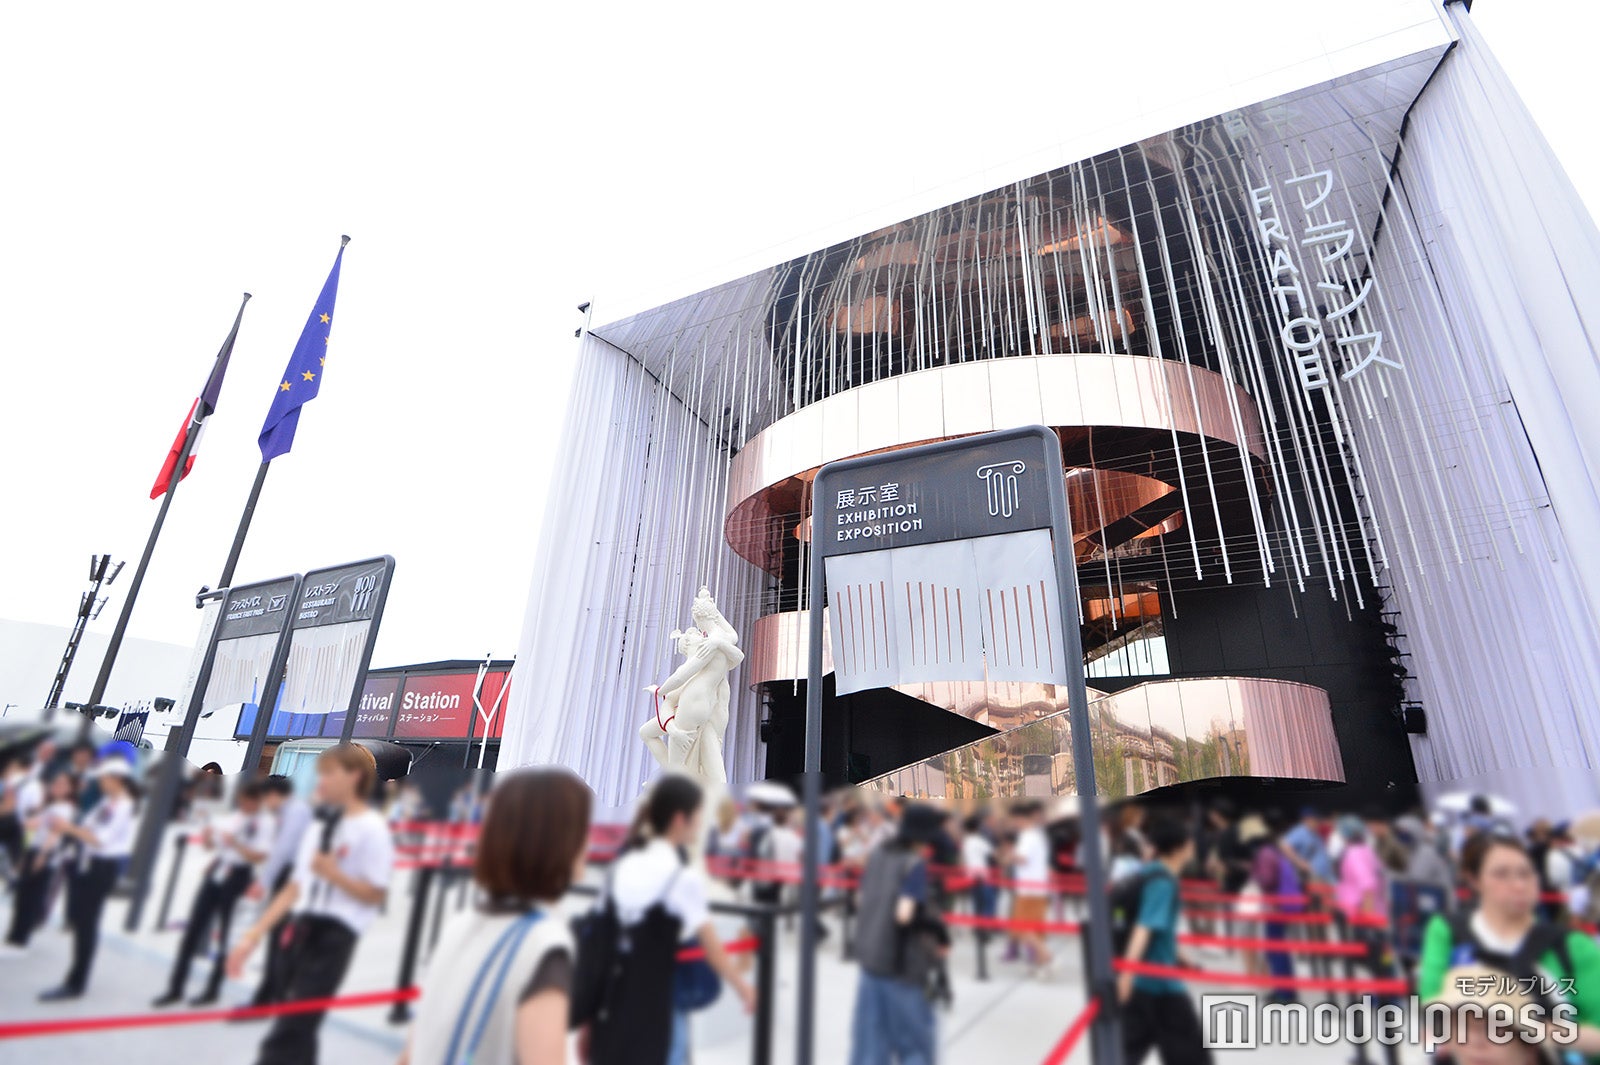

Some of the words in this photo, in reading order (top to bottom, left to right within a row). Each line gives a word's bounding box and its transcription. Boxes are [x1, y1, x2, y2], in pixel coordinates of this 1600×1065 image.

[1284, 169, 1404, 382] フランス
[1250, 185, 1329, 391] FRANCE
[836, 482, 900, 510] 展示室
[837, 503, 917, 526] EXHIBITION
[837, 518, 923, 542] EXPOSITION
[305, 583, 340, 597] レストラン
[231, 596, 262, 611] ファストパス
[358, 693, 394, 710] tival
[402, 691, 460, 710] Station
[399, 713, 440, 722] ステーション
